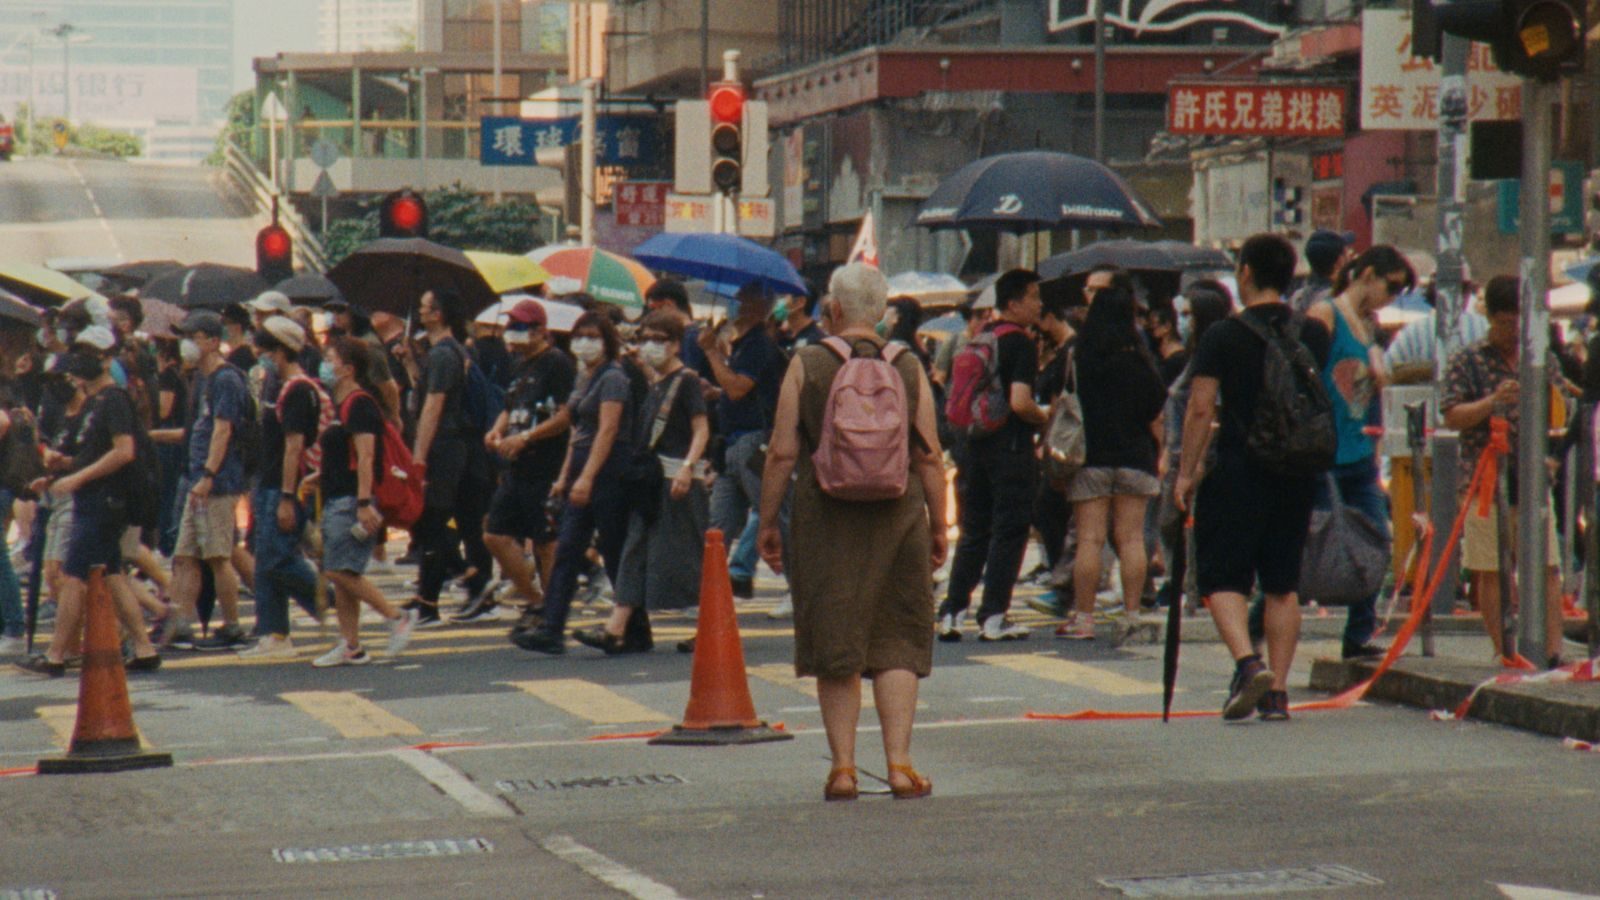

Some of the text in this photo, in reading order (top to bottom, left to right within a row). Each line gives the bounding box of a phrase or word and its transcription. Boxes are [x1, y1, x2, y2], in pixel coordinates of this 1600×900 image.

[1174, 89, 1342, 131] 許氏兄弟找換
